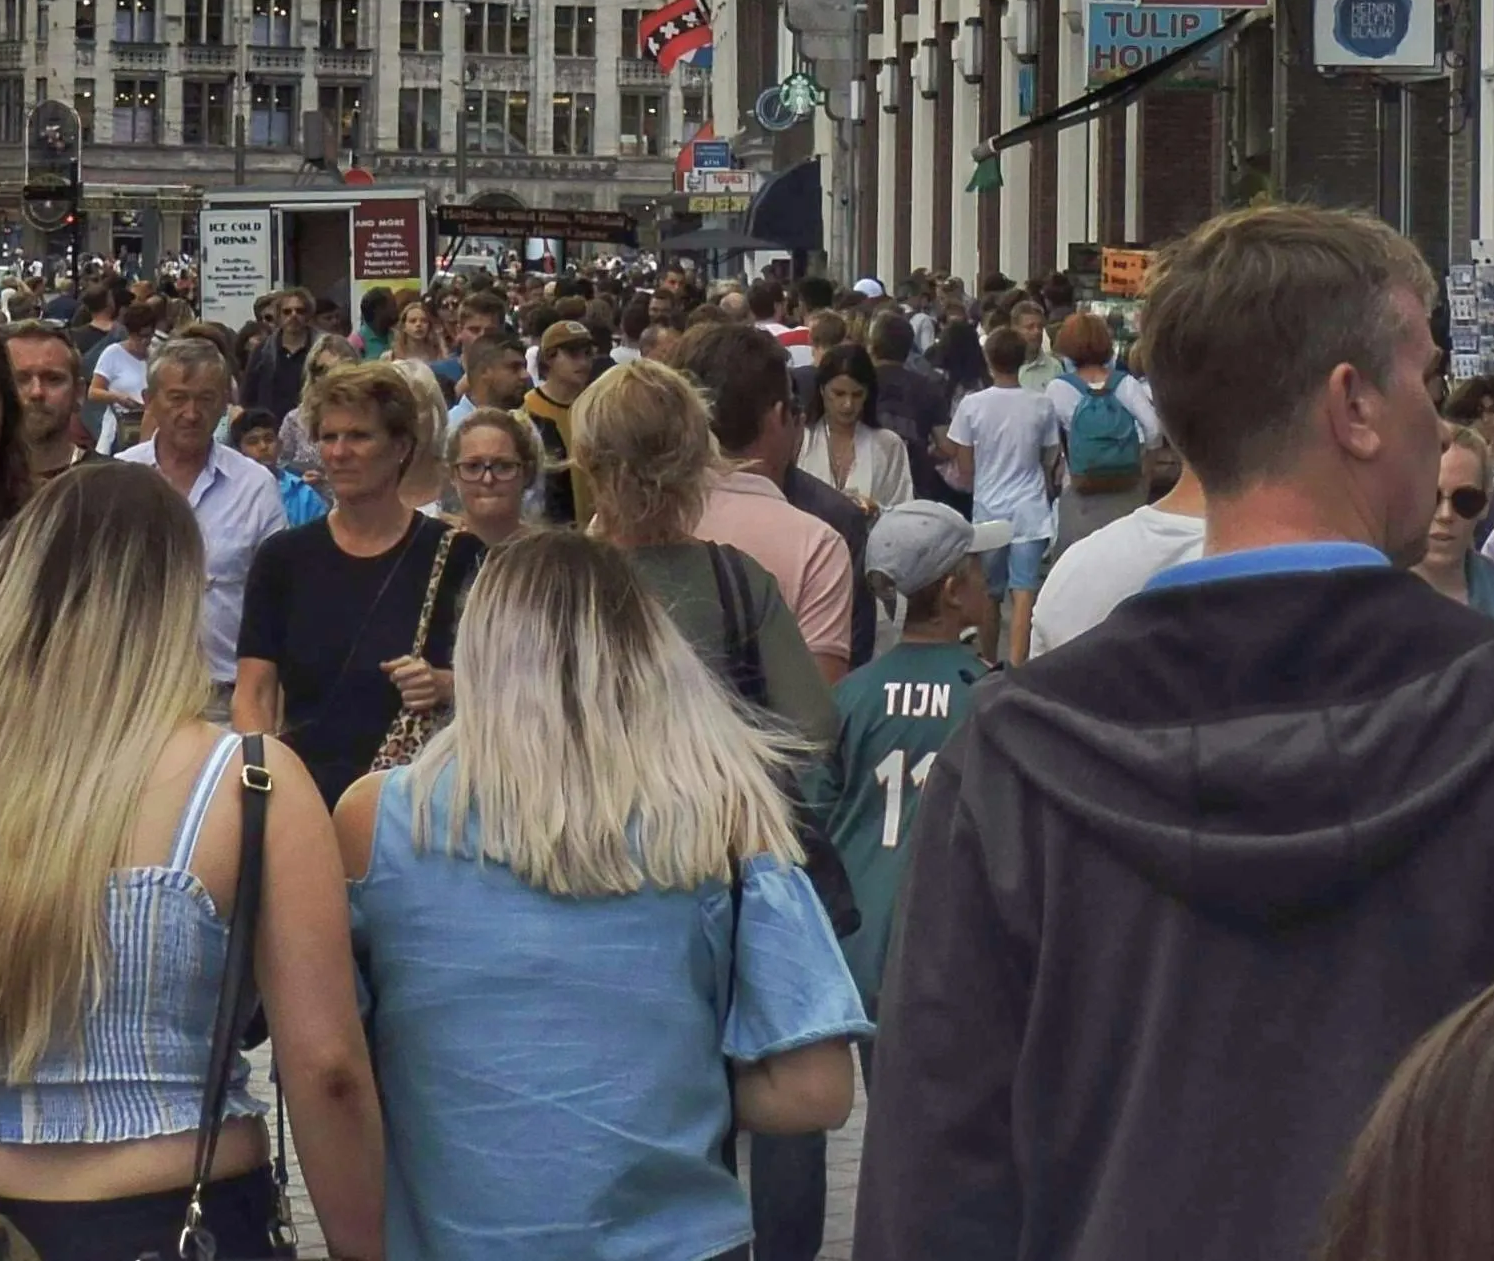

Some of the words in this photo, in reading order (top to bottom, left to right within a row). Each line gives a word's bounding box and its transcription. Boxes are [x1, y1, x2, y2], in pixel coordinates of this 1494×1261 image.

[1105, 11, 1201, 39] TULIP
[1093, 44, 1212, 71] HOUE
[209, 222, 226, 233] ICE
[231, 221, 262, 232] COLD
[354, 220, 375, 228] AND
[378, 218, 406, 227] MORE
[213, 235, 258, 246] DRINKS
[883, 682, 951, 718] TIJN
